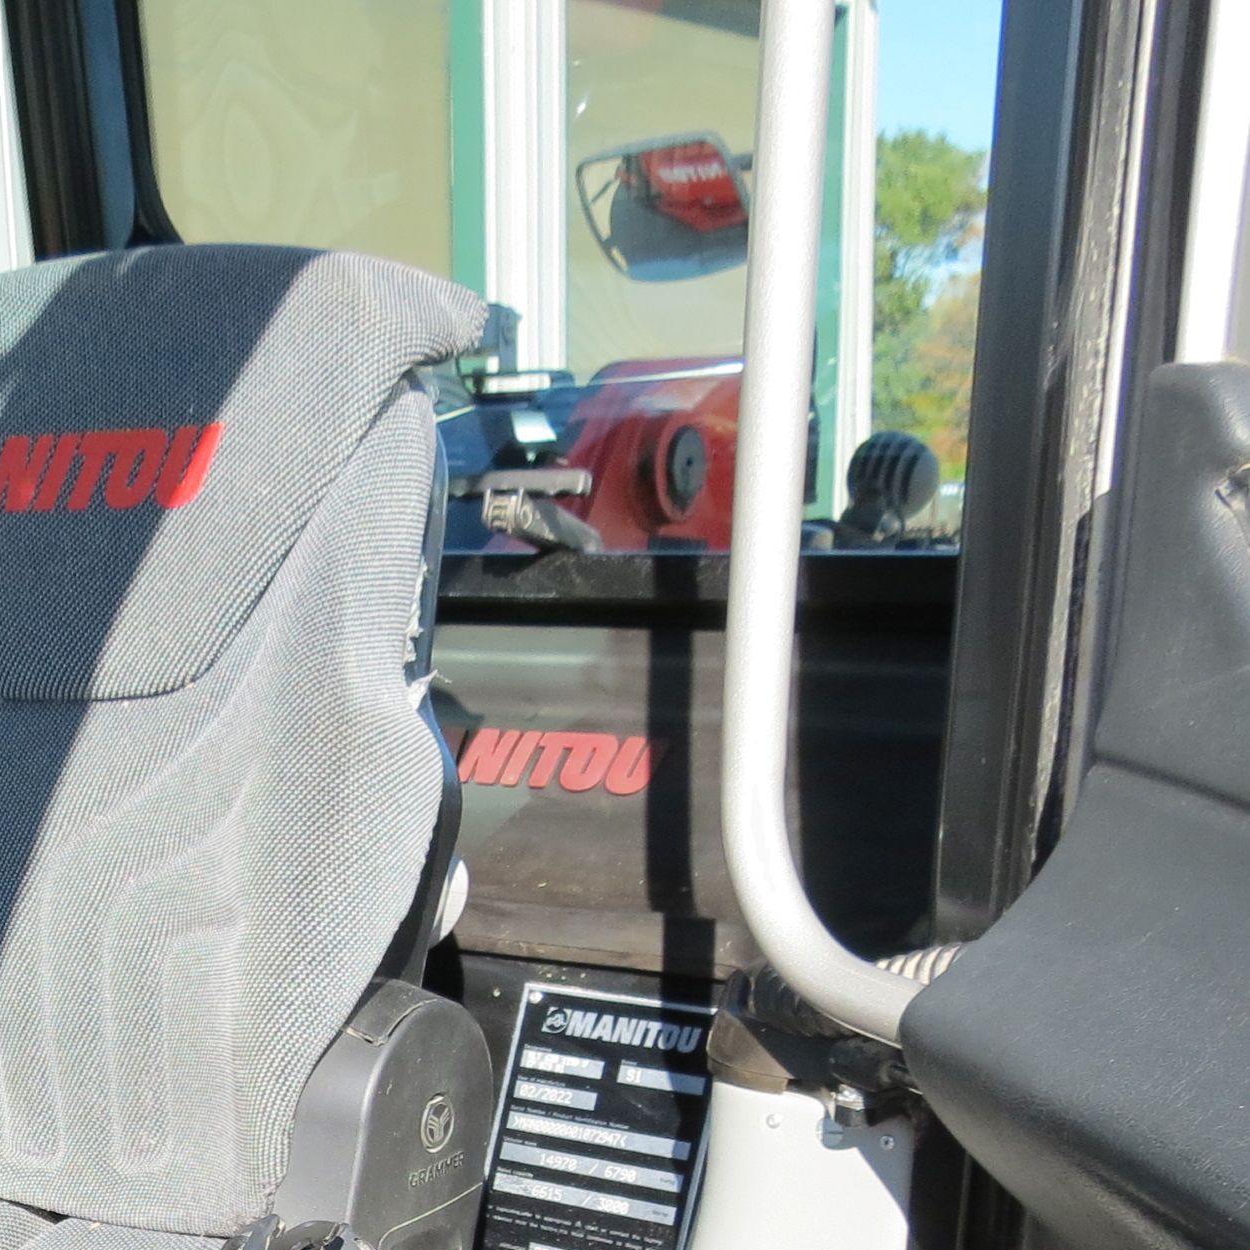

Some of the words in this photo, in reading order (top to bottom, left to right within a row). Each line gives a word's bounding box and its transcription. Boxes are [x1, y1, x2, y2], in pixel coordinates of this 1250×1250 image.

[566, 1009, 701, 1053] MANITOU
[519, 1084, 573, 1104] 02/2022
[409, 1151, 464, 1189] GRAMMER
[539, 1154, 578, 1171] 14970
[604, 1165, 637, 1182] 6790
[596, 1196, 630, 1215] 3000
